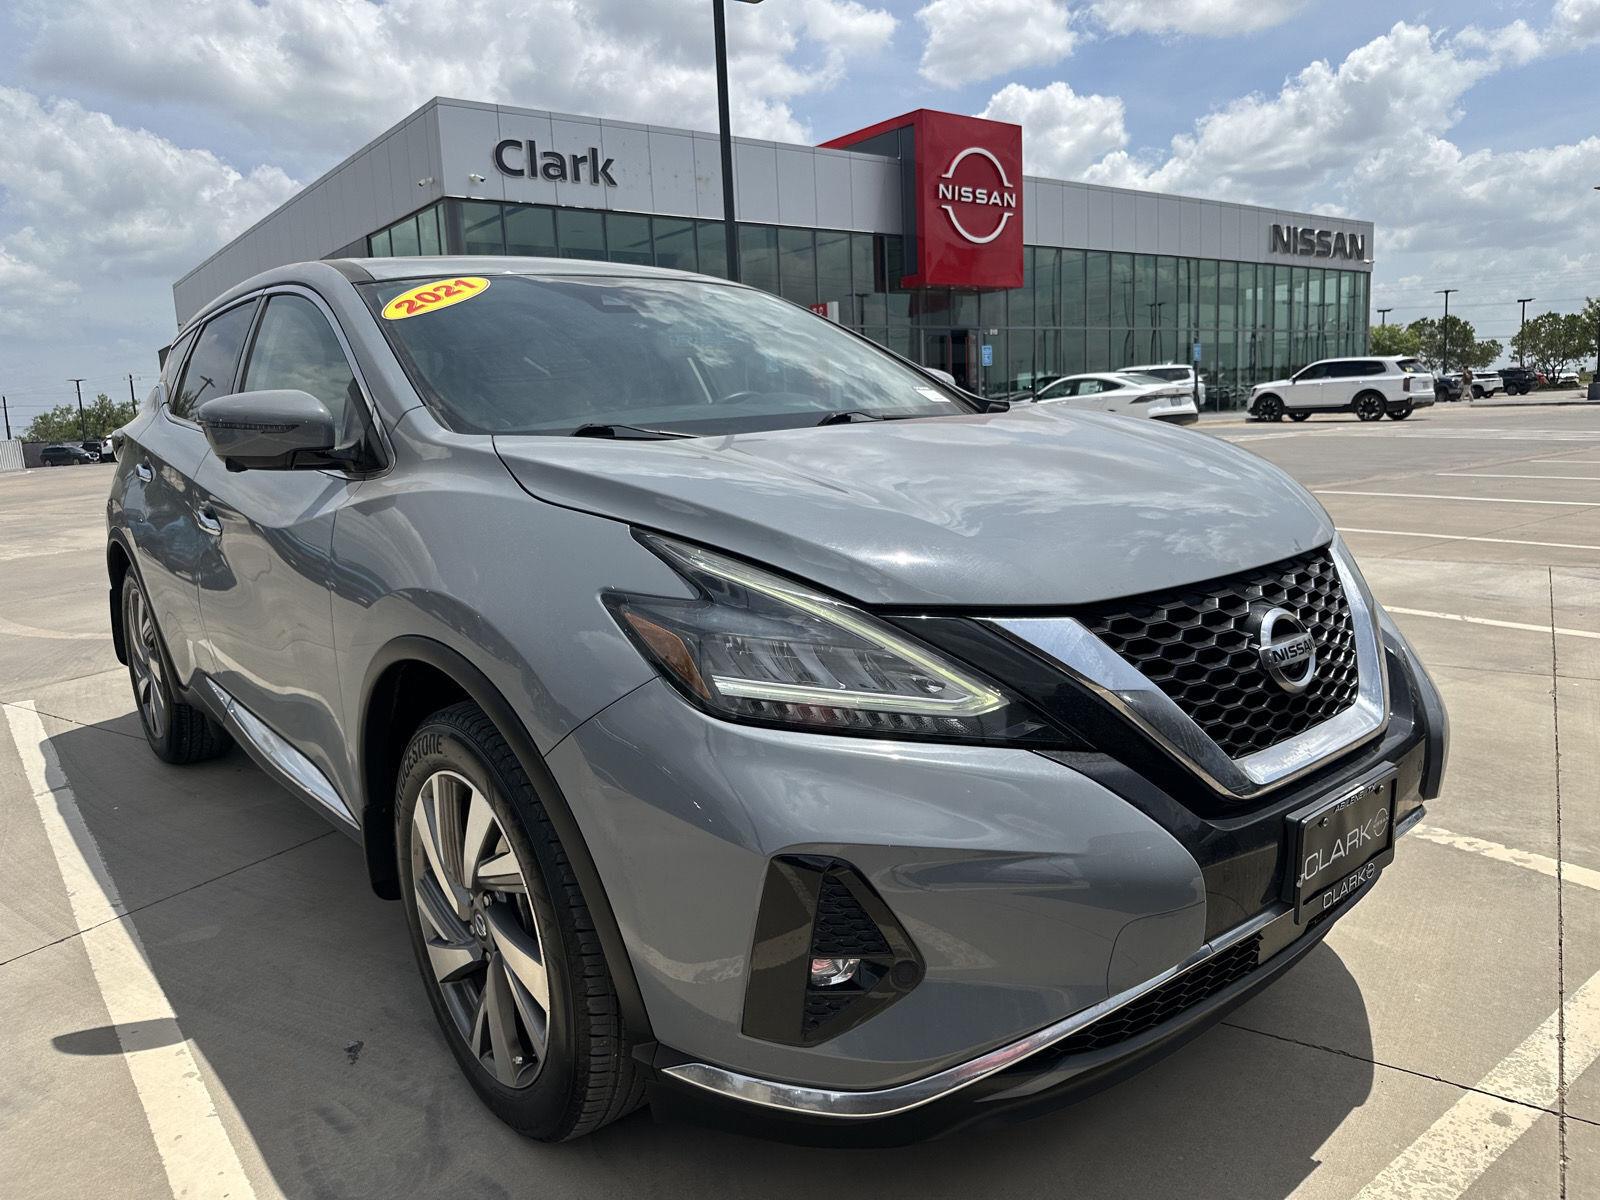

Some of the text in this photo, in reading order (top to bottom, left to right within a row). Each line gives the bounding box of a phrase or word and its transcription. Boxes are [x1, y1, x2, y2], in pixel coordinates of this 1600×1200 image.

[493, 139, 617, 187] Clark
[938, 183, 1016, 208] NISSAN
[1269, 224, 1365, 261] NISSAN
[395, 280, 479, 315] 2021
[1272, 637, 1314, 662] NISSAN
[1304, 818, 1373, 880] CLARK
[1323, 867, 1366, 909] CLARK
